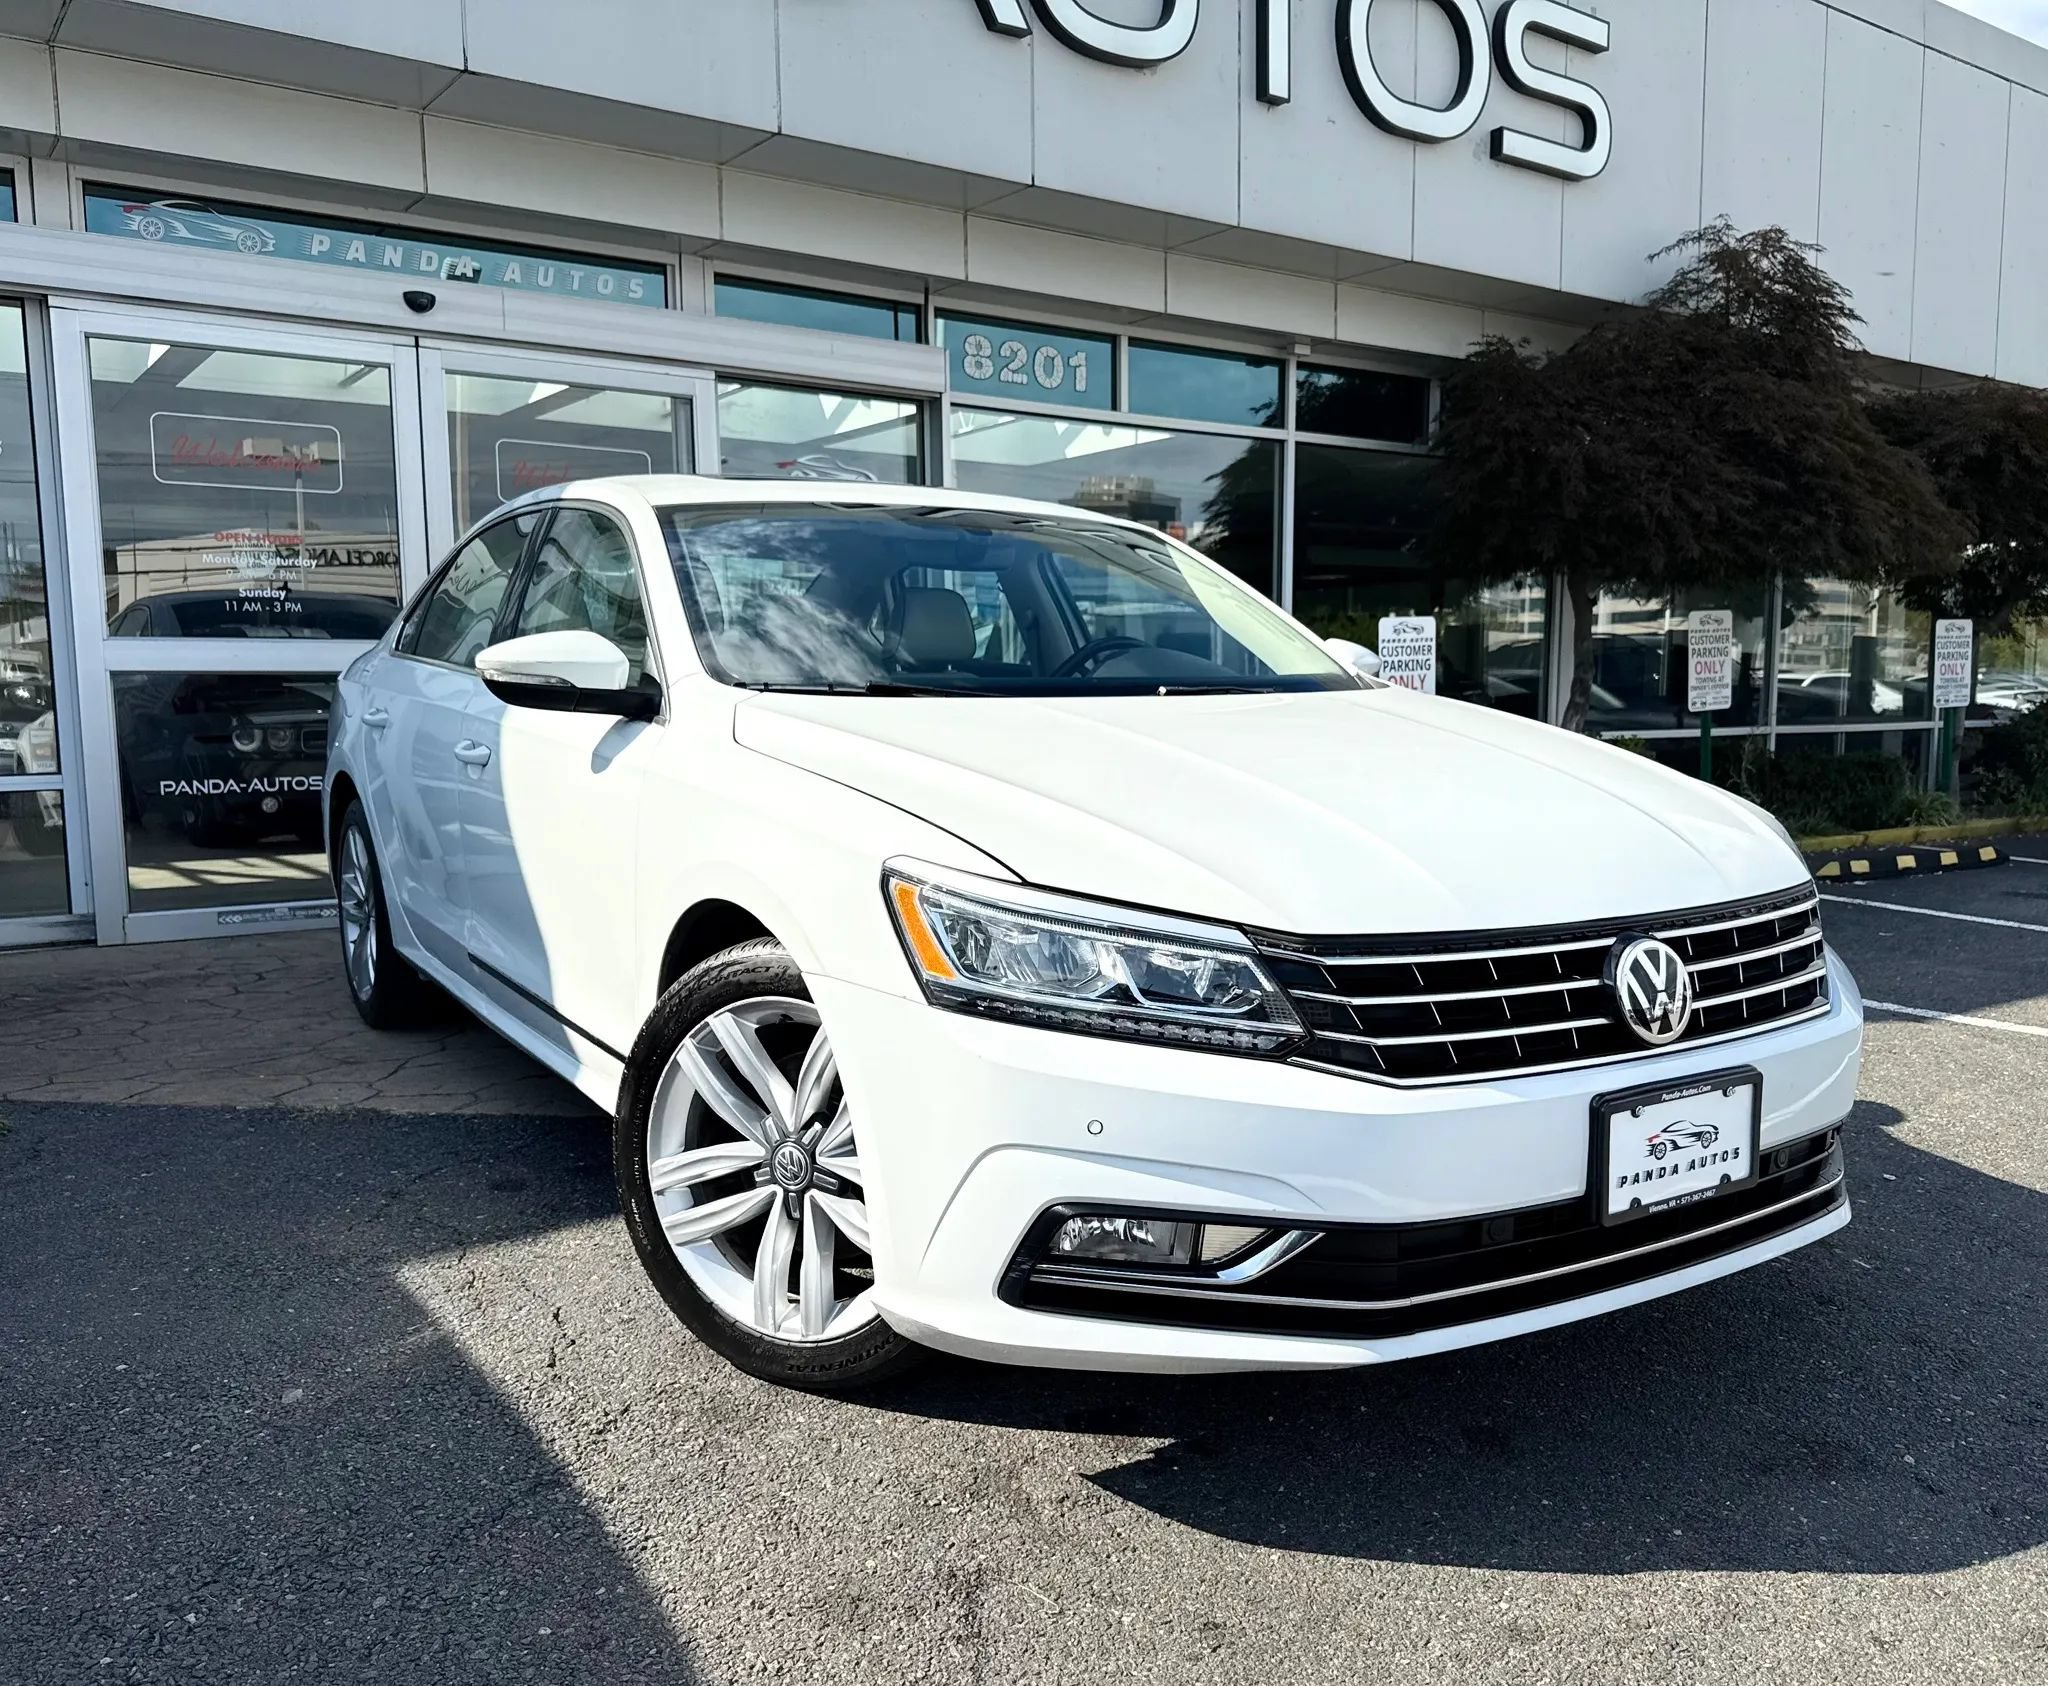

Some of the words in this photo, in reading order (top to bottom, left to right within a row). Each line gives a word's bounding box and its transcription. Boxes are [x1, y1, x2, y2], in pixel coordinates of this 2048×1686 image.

[307, 233, 474, 278] PANDA
[502, 261, 644, 299] AUTOS
[963, 334, 1087, 393] 8201
[214, 532, 254, 545] OPEN
[280, 571, 297, 580] PM
[238, 587, 287, 600] Sunday
[225, 601, 238, 612] 11
[242, 601, 262, 612] AM
[273, 602, 281, 612] 3
[285, 602, 303, 612] PM
[1689, 634, 1731, 646] CUSTOMER
[1936, 640, 1970, 650] CUSTOMER
[1381, 645, 1433, 658] CUSTOMER
[1691, 646, 1729, 658] PARKING
[1937, 651, 1969, 661] PARKING
[1383, 659, 1431, 673] PARKING
[1695, 660, 1725, 676] ONLY
[1940, 662, 1965, 676] ONLY
[160, 775, 323, 796] PANDA-AUTOS
[1617, 1164, 1679, 1188] PANDA
[1686, 1147, 1740, 1172] AUTOS
[784, 1333, 897, 1375] ONTINENTAL
